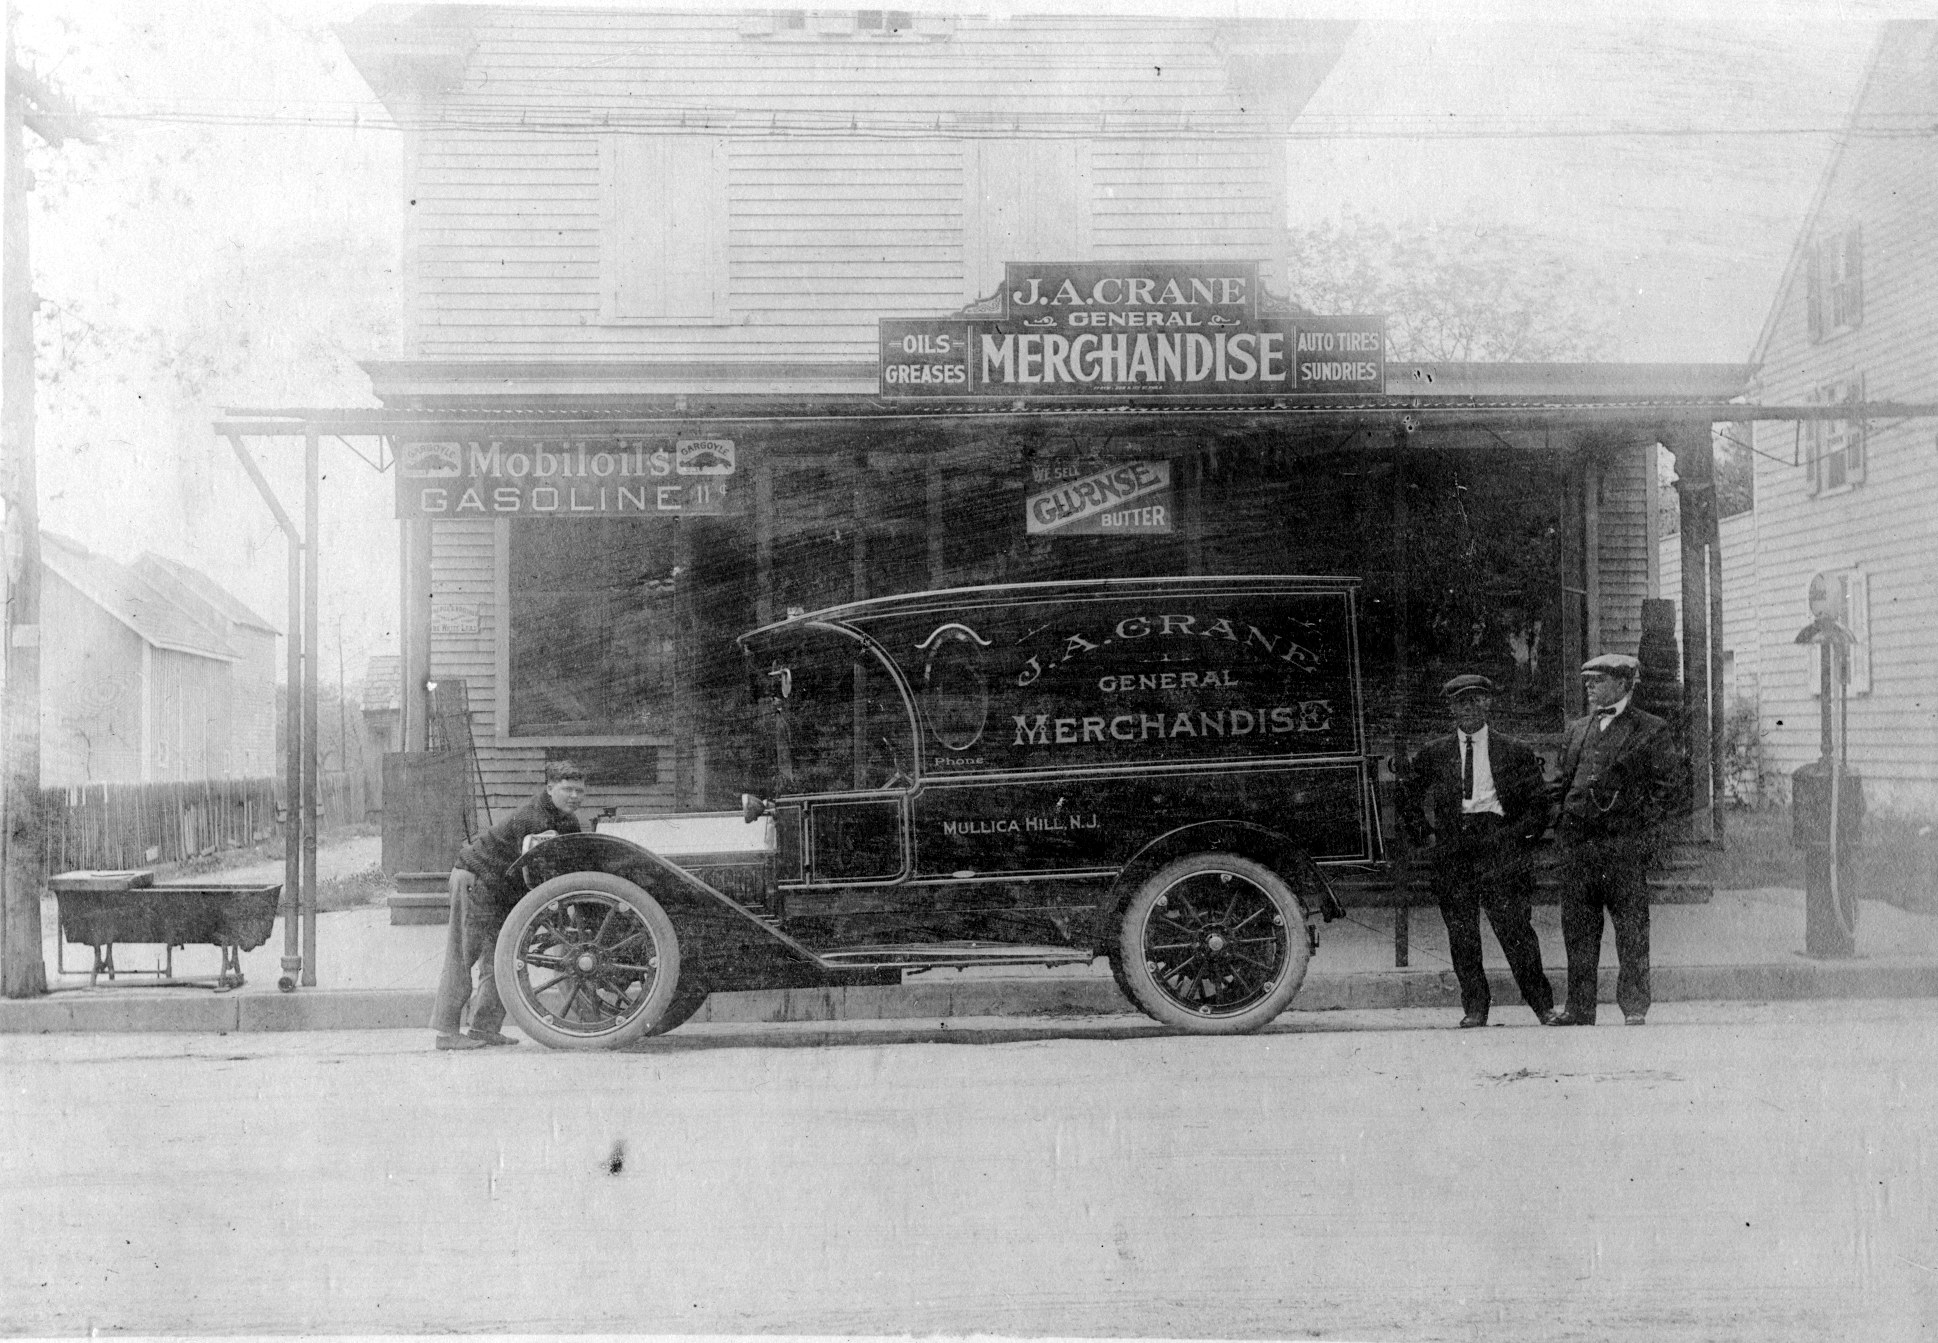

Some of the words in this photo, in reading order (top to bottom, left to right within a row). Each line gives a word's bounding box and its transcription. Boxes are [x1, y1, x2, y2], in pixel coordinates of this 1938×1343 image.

[1068, 311, 1202, 327] GENERAL
[903, 334, 951, 354] OILS
[1297, 332, 1334, 352] AUTO
[1337, 332, 1379, 352] TIRES
[981, 332, 1286, 384] MERCHANDISE
[885, 364, 966, 384] GREASES
[1301, 361, 1377, 381] SUNDRIES
[407, 443, 456, 459] GARGOYLE
[468, 440, 671, 478] Mobiloils
[680, 441, 730, 457] GARGOYLE
[421, 486, 683, 512] GASOLINE
[1101, 505, 1165, 527] BUTTER
[1100, 670, 1239, 692] GENERAL
[1012, 700, 1334, 746] MERCHANDISE
[935, 757, 984, 767] Phone
[943, 820, 1020, 835] MULLICA
